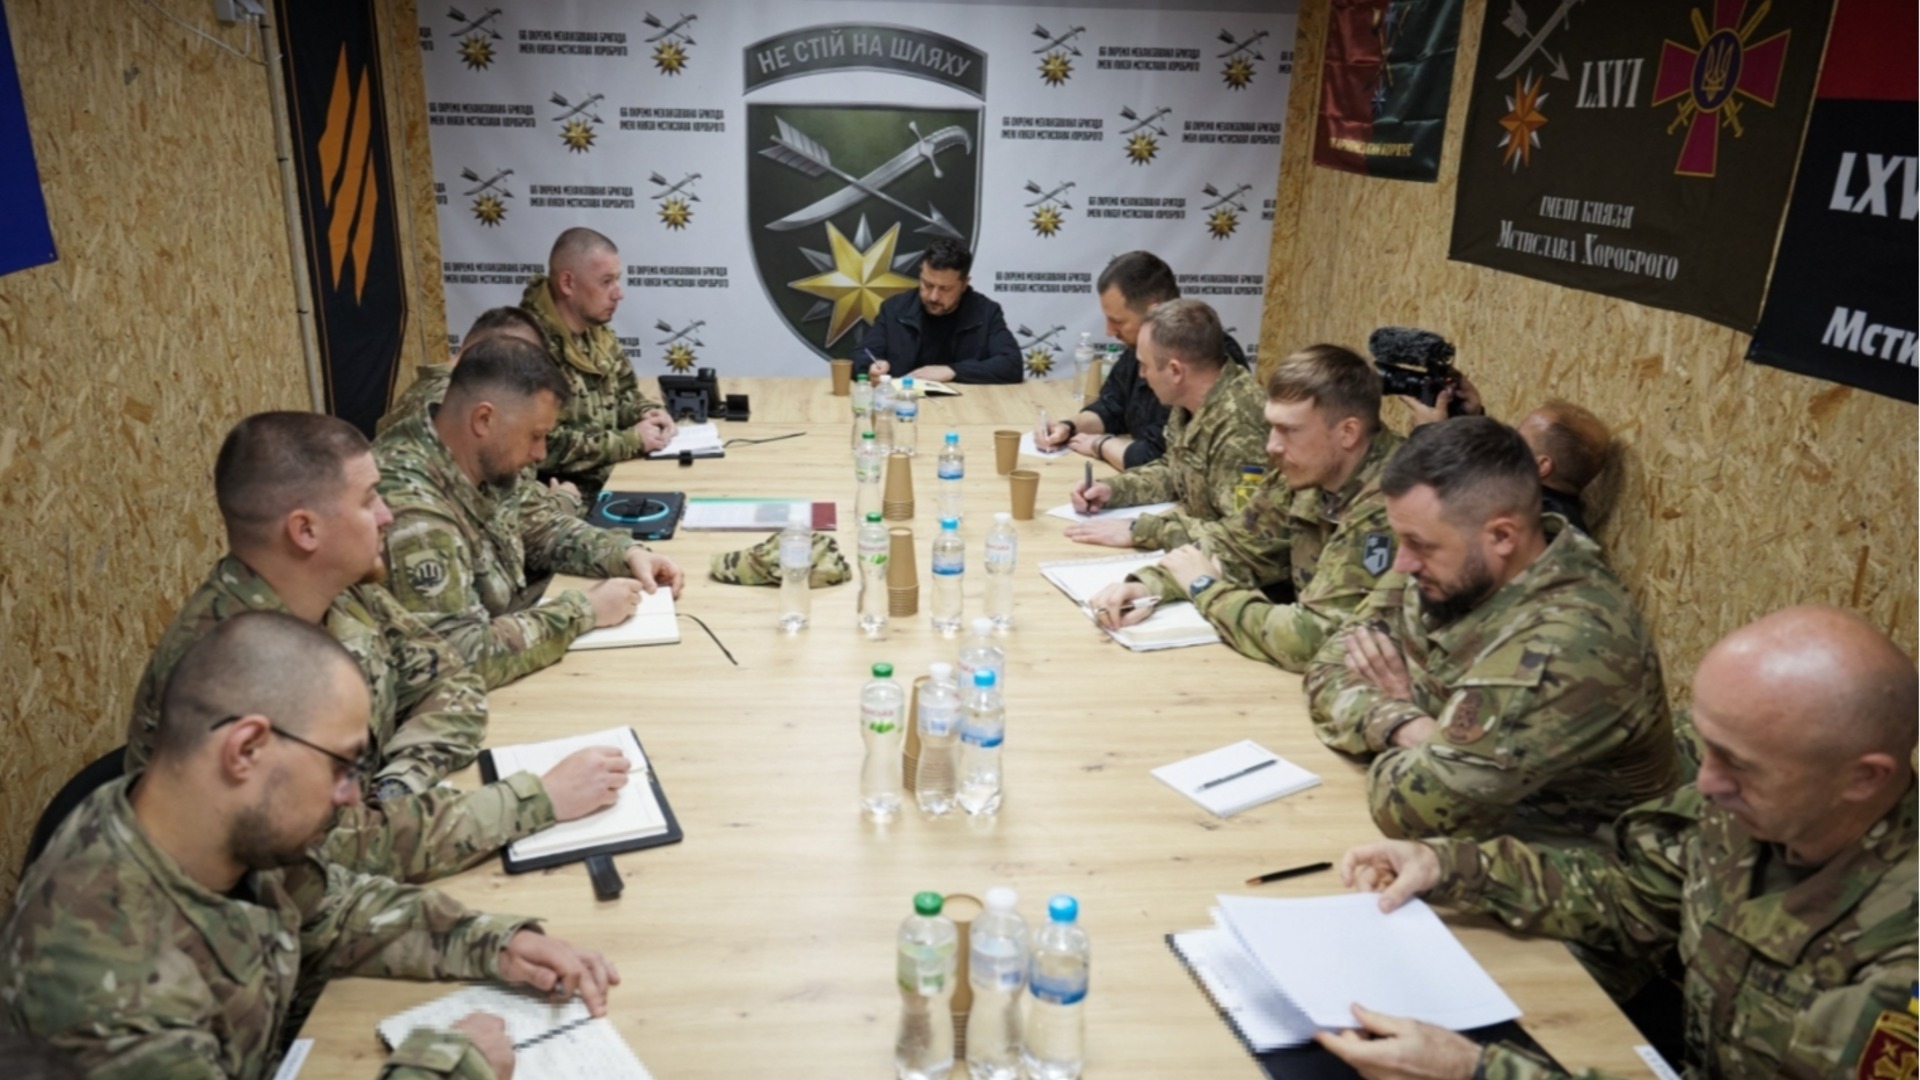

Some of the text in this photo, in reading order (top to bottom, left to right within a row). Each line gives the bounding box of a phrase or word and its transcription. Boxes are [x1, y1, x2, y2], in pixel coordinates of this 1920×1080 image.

[757, 29, 971, 77] НЕ СТІЙ НА ШЛЯХУ
[1576, 58, 1645, 109] LXVI
[1539, 195, 1635, 229] ІМЕНІ КНЯЗЯ
